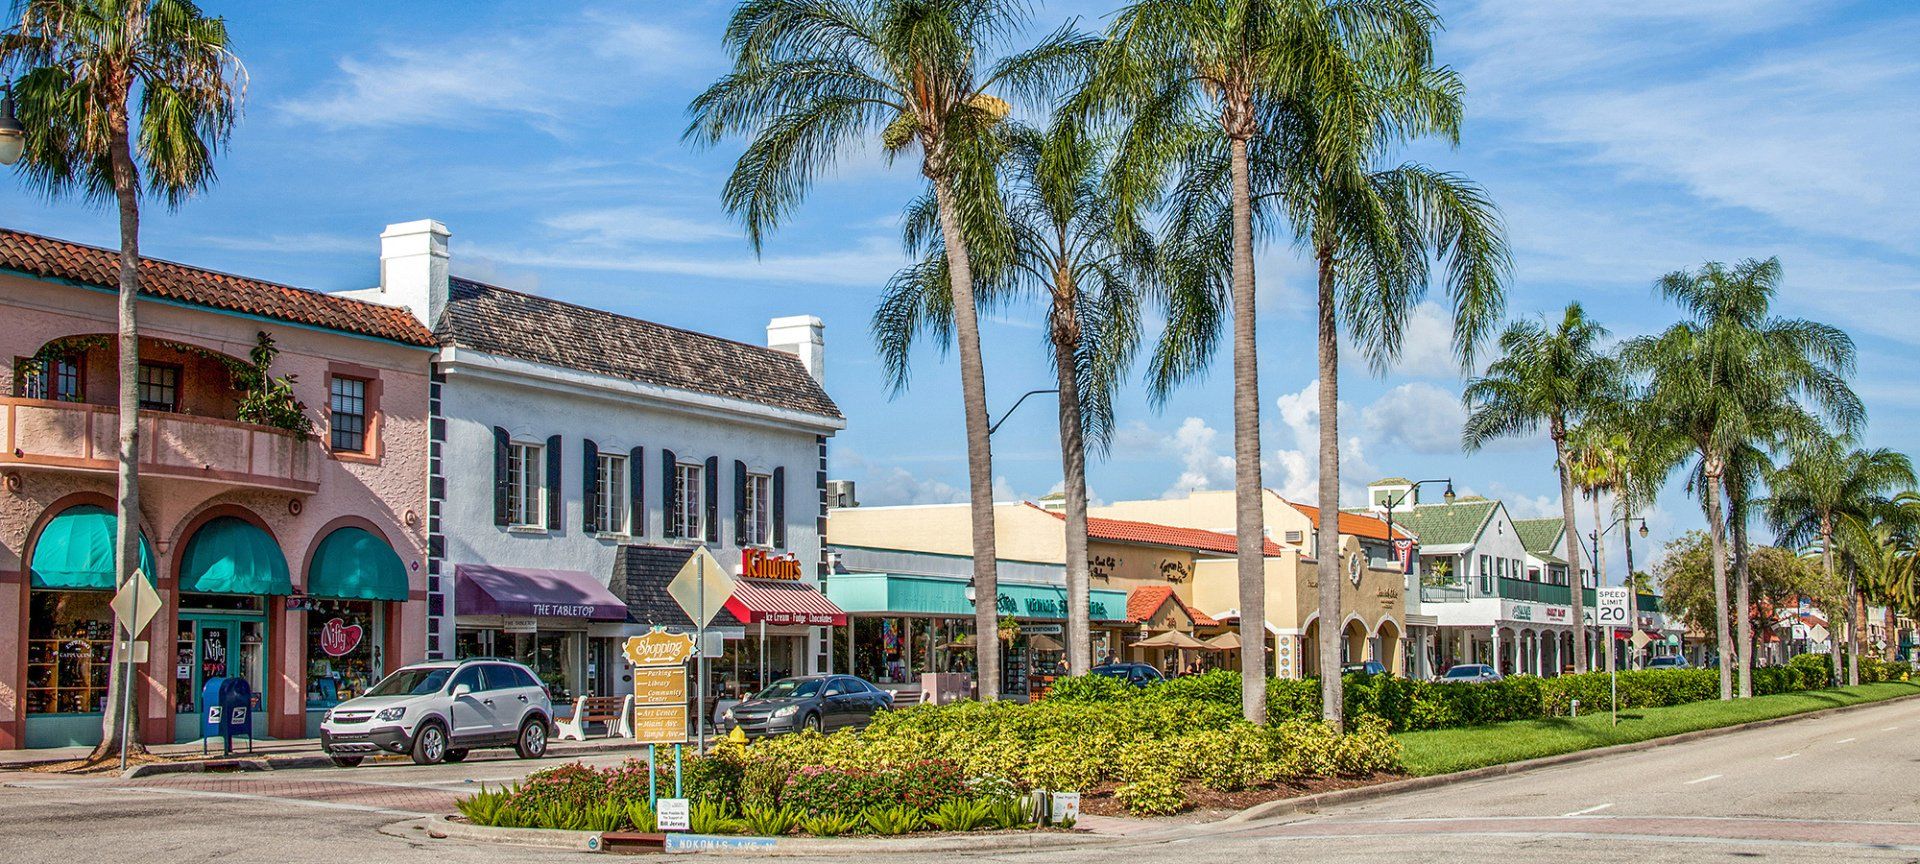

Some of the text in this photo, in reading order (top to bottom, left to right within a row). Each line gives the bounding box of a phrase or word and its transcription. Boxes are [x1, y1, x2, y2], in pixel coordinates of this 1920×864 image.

[533, 604, 595, 617] THE TABLETOP
[1600, 607, 1625, 620] 20
[774, 612, 789, 622] Cream
[793, 613, 806, 624] Fudge
[809, 613, 832, 624] Chocolates
[322, 623, 346, 651] Nifty
[204, 638, 226, 664] Nifty
[636, 638, 683, 658] Shopping
[666, 839, 672, 848] S
[680, 839, 728, 849] NOKOMIS
[737, 841, 758, 850] AVE
